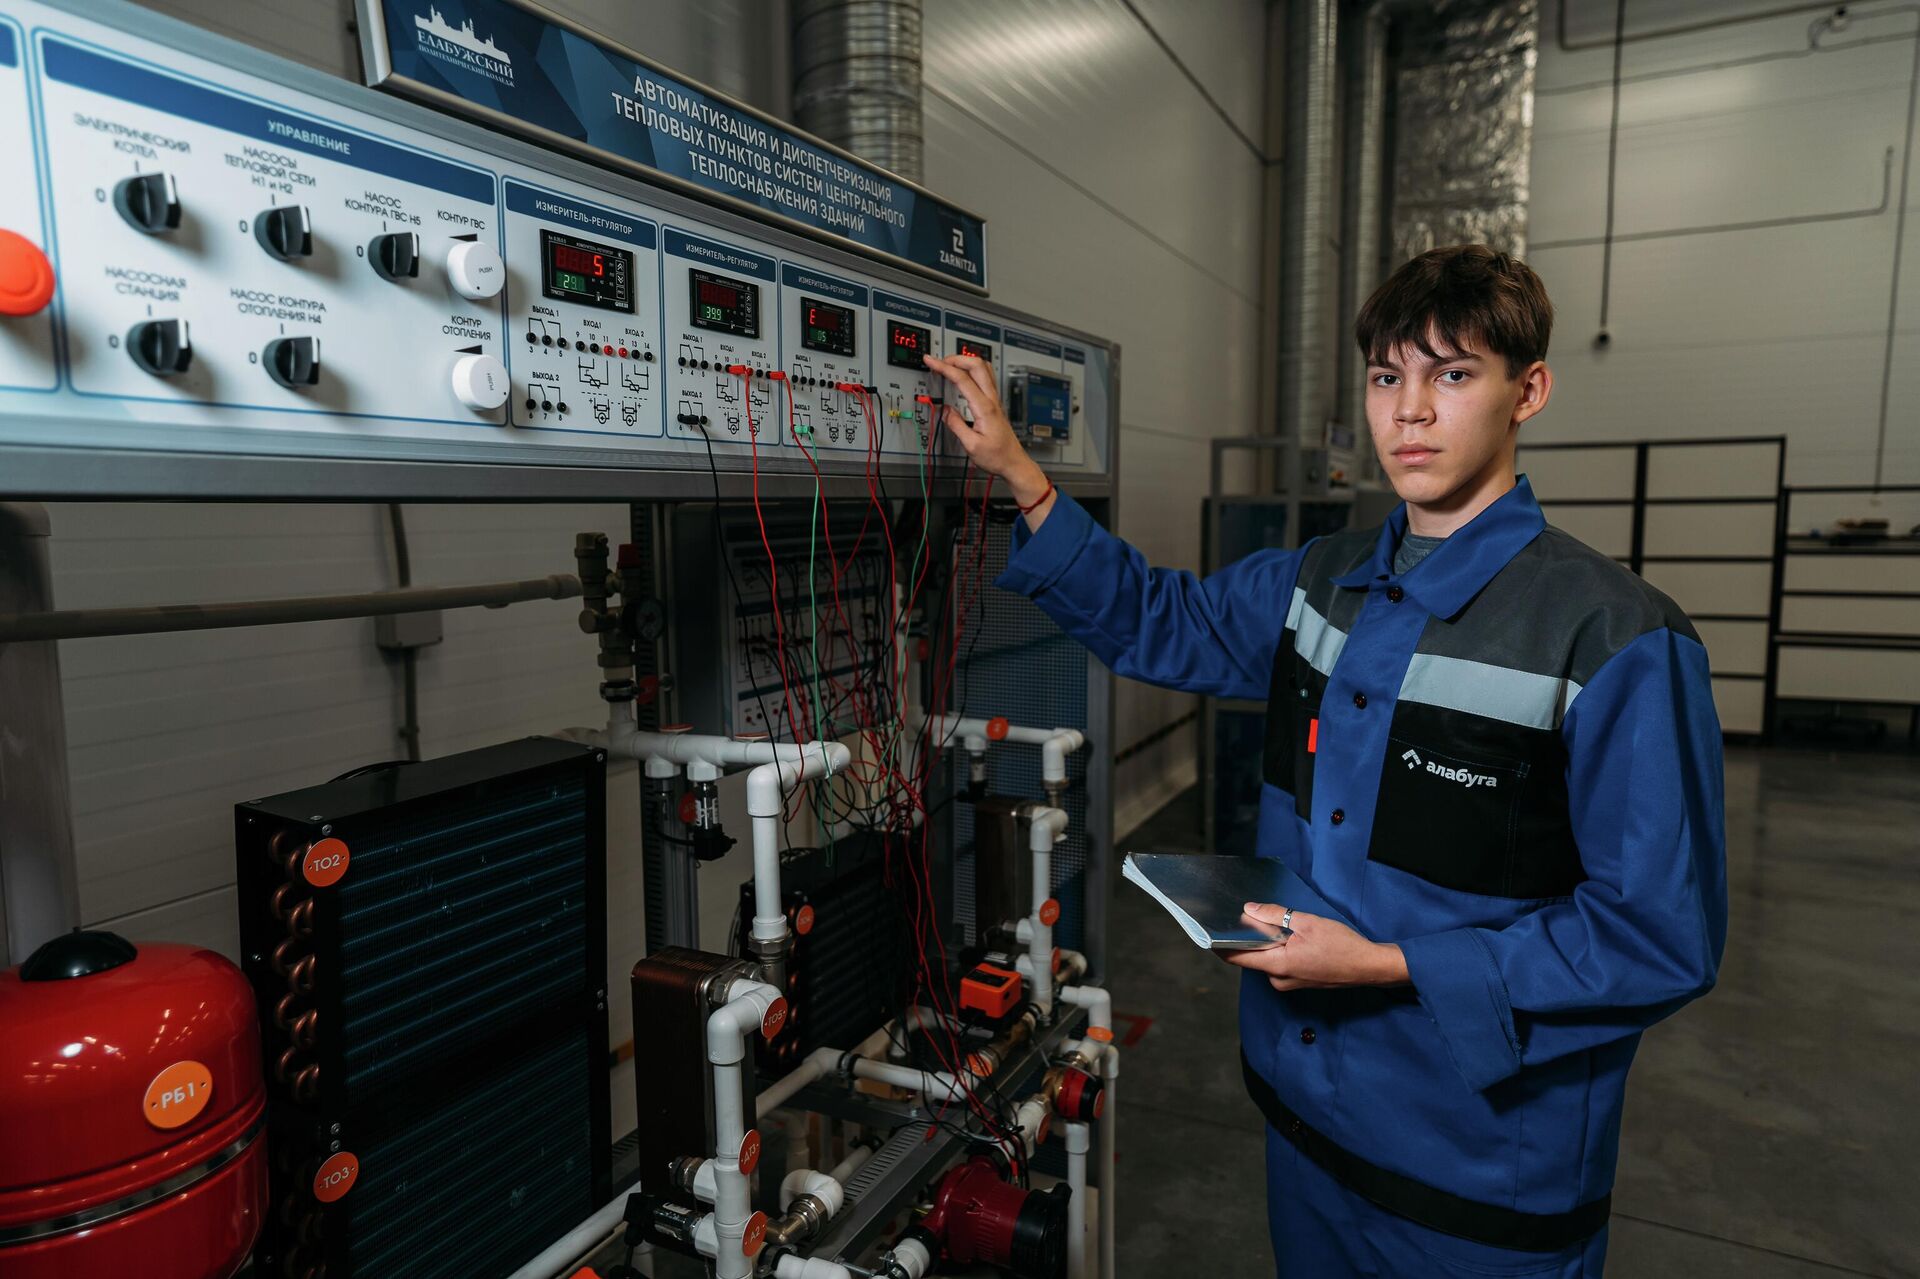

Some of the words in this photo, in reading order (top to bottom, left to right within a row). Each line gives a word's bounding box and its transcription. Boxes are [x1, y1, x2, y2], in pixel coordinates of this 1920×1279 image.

[417, 30, 514, 79] ЕЛАБУЖСКИЙ
[74, 112, 191, 153] ЭЛЕКТРИЧЕСКИЙ
[267, 119, 351, 156] УПРАВЛЕНИЕ
[634, 75, 767, 150] АВТОМАТИЗАЦИЯ
[770, 135, 779, 153] И
[783, 141, 892, 202] ДИСПЕТЧЕРИЗАЦИЯ
[243, 145, 297, 169] НАСОСЫ
[611, 92, 705, 148] ТЕПЛОВЫХ
[708, 133, 771, 175] ПУНКТОВ
[774, 161, 823, 196] СИСТЕМ
[826, 185, 905, 228] ЦЕНТРАЛЬНОГО
[224, 153, 287, 179] ТЕПЛОВОЙ
[288, 171, 316, 187] СЕТИ
[365, 191, 402, 209] НАСОС
[689, 151, 818, 216] ТЕПЛОСНАБЖЕНИЯ
[820, 202, 865, 234] ЗДАНИЙ
[344, 198, 389, 217] КОНТУРА
[390, 209, 407, 223] ГВС
[437, 210, 469, 225] КОНТУР
[470, 217, 486, 230] ГВС
[535, 199, 633, 235] ИЗМЕРИТЕЛЬ-РЕГУЛЯТОР
[685, 243, 758, 270] ИЗМЕРИТЕЛЬ-РЕГУЛЯТОР
[940, 250, 977, 274] ZARNITZA
[105, 266, 187, 289] НАСОСНАЯ
[115, 282, 180, 301] СТАНЦИЯ
[230, 288, 275, 305] НАСОС
[278, 295, 327, 312] КОНТУРА
[238, 303, 306, 321] ОТОПЛЕНИЯ
[451, 315, 482, 328] КОНТУР
[532, 305, 555, 317] ВЫХОД
[442, 325, 492, 341] ОТОПЛЕНИЯ
[625, 328, 640, 337] ВХОД
[532, 371, 555, 381] ВЫХОД
[1426, 761, 1497, 788] алабуга
